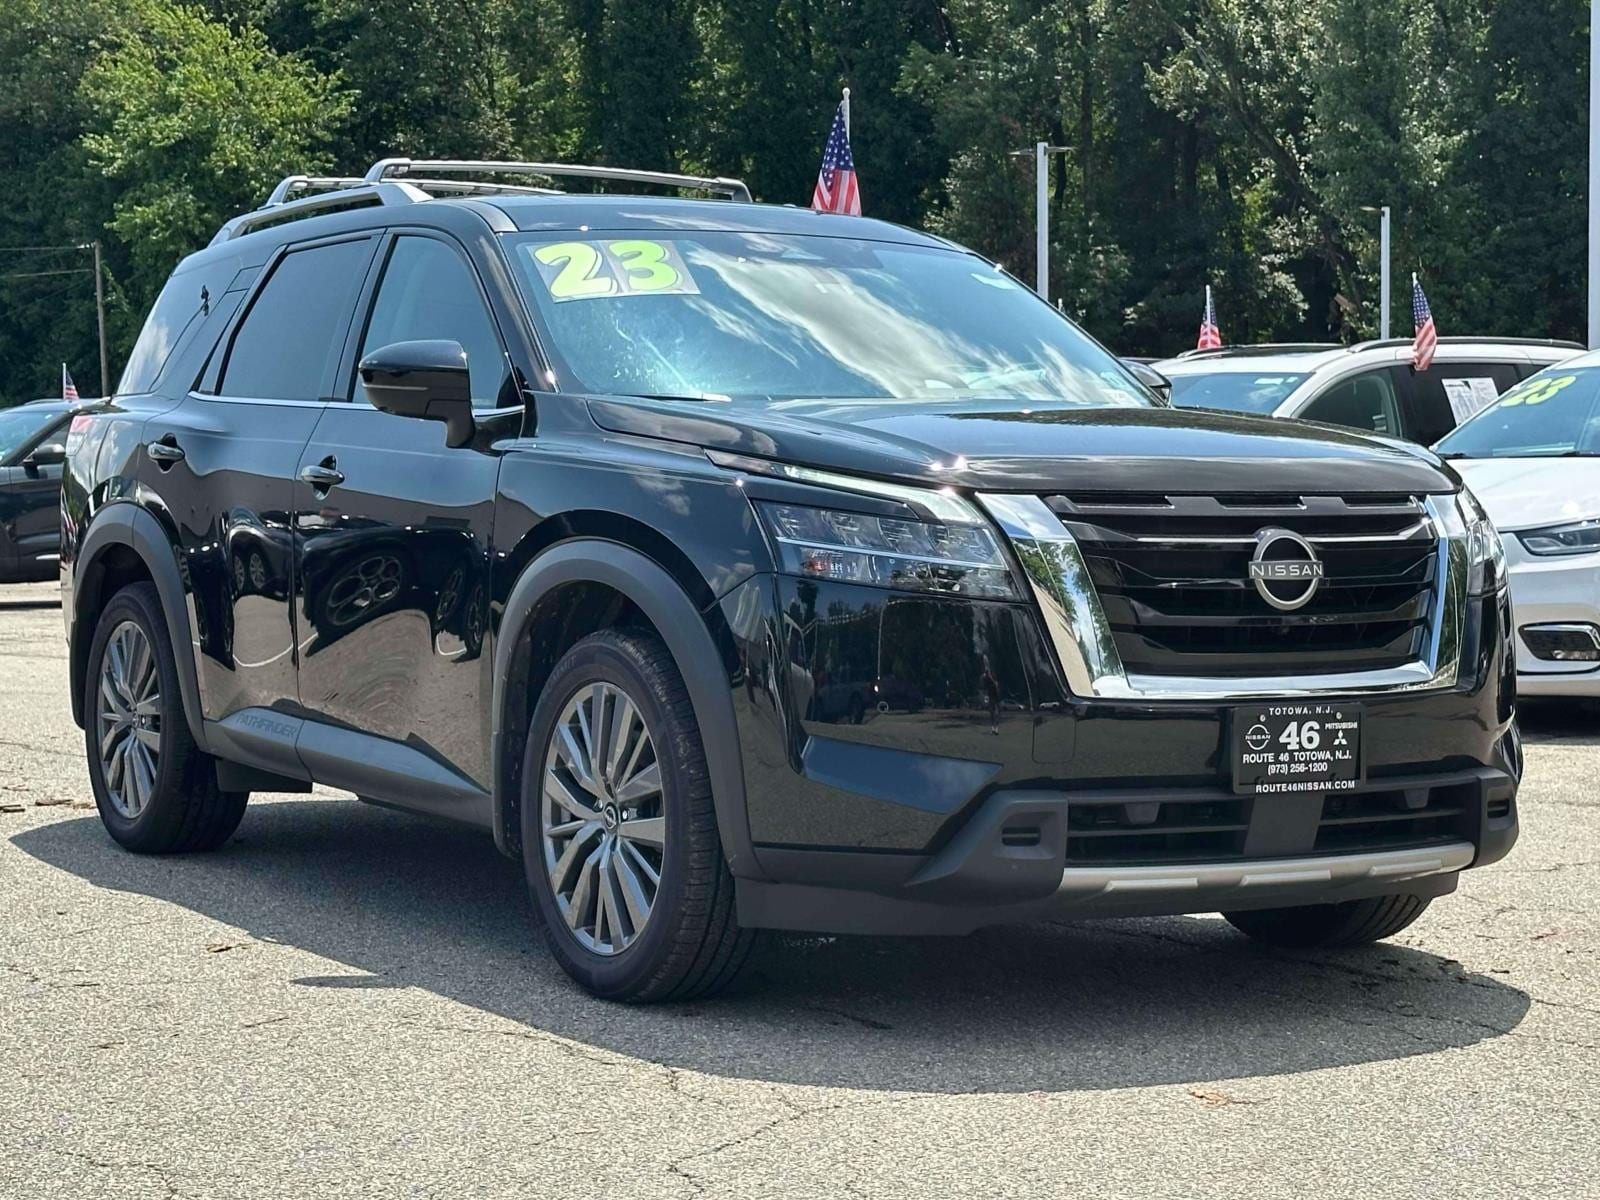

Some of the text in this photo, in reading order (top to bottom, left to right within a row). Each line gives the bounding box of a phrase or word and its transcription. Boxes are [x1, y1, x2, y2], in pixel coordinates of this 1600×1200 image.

[534, 240, 684, 298] 23
[1500, 375, 1577, 407] 23
[1250, 563, 1323, 577] NISSAN
[1269, 705, 1334, 716] TOTOWA, N.J.
[236, 712, 298, 737] PATHFINDER
[1324, 721, 1358, 730] MITSUBISHI
[1244, 733, 1271, 741] NISSAN
[1278, 720, 1321, 751] 46
[1242, 749, 1352, 764] ROUTE 46 TOTOWA, N.J.
[1267, 762, 1328, 776] (973) 256-1200
[1255, 780, 1356, 793] ROUTE46NISSAN.COM
